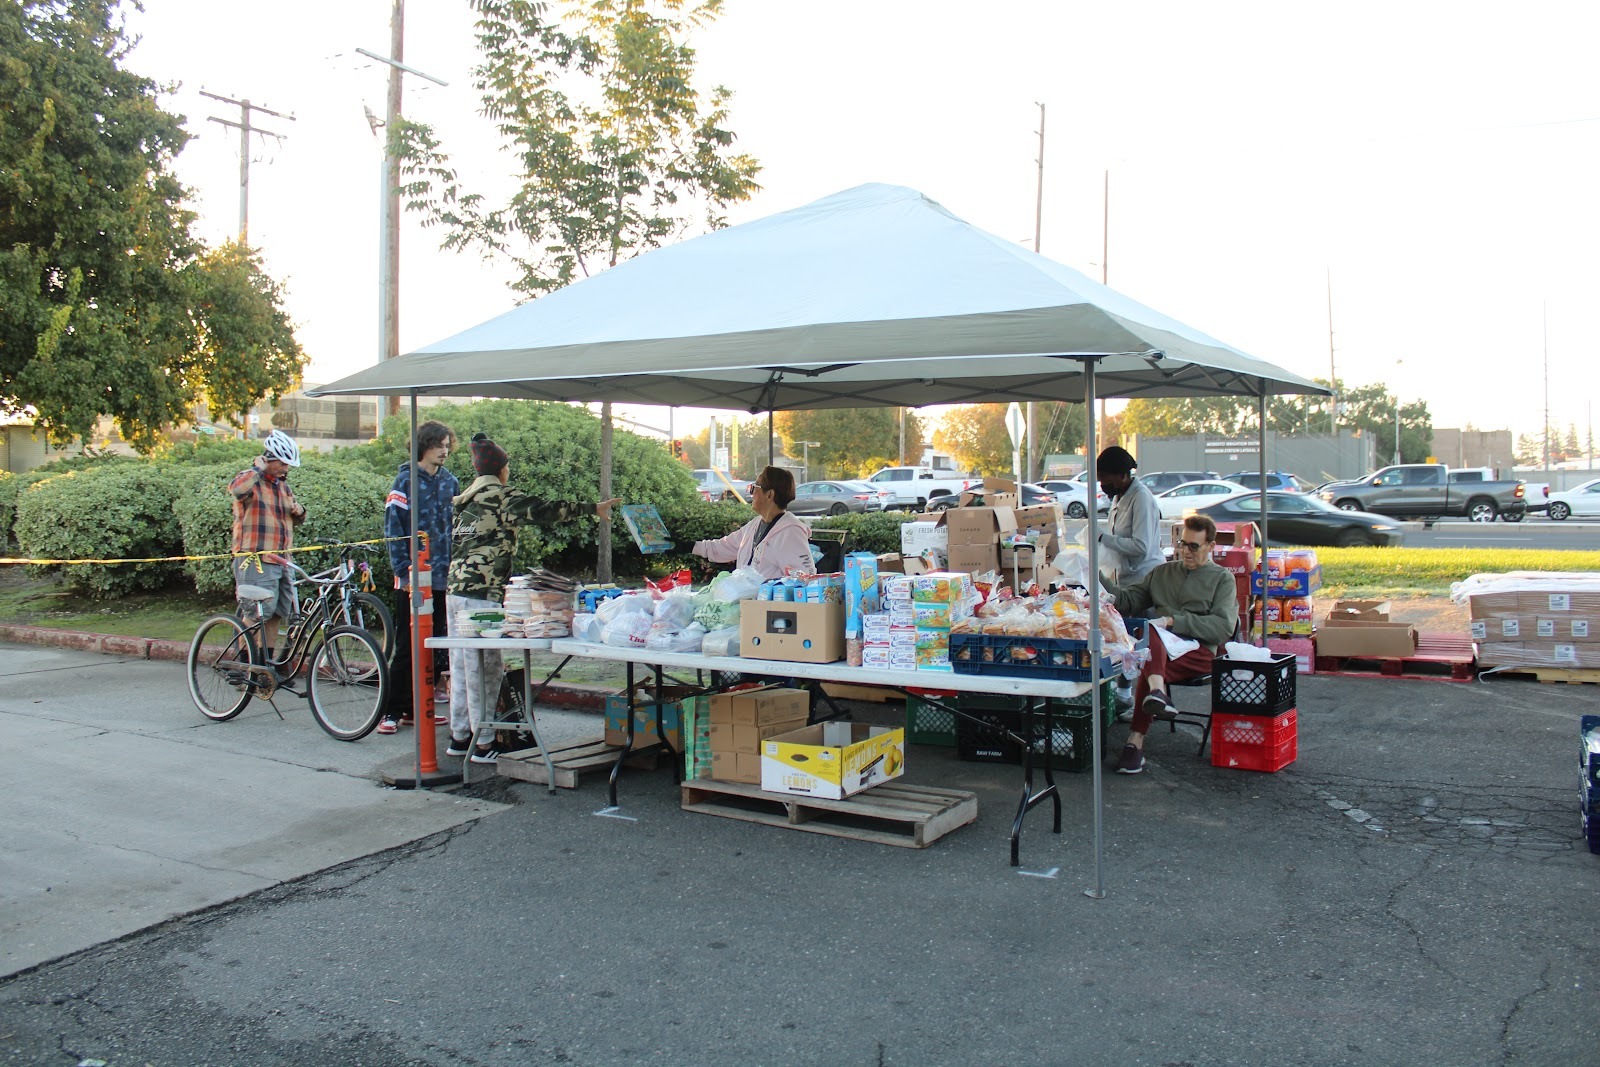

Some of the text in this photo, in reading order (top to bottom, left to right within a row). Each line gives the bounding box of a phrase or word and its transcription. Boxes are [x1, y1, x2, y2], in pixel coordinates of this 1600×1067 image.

[1255, 578, 1284, 588] Cties
[629, 634, 645, 643] Tha
[782, 775, 817, 789] LEMONS
